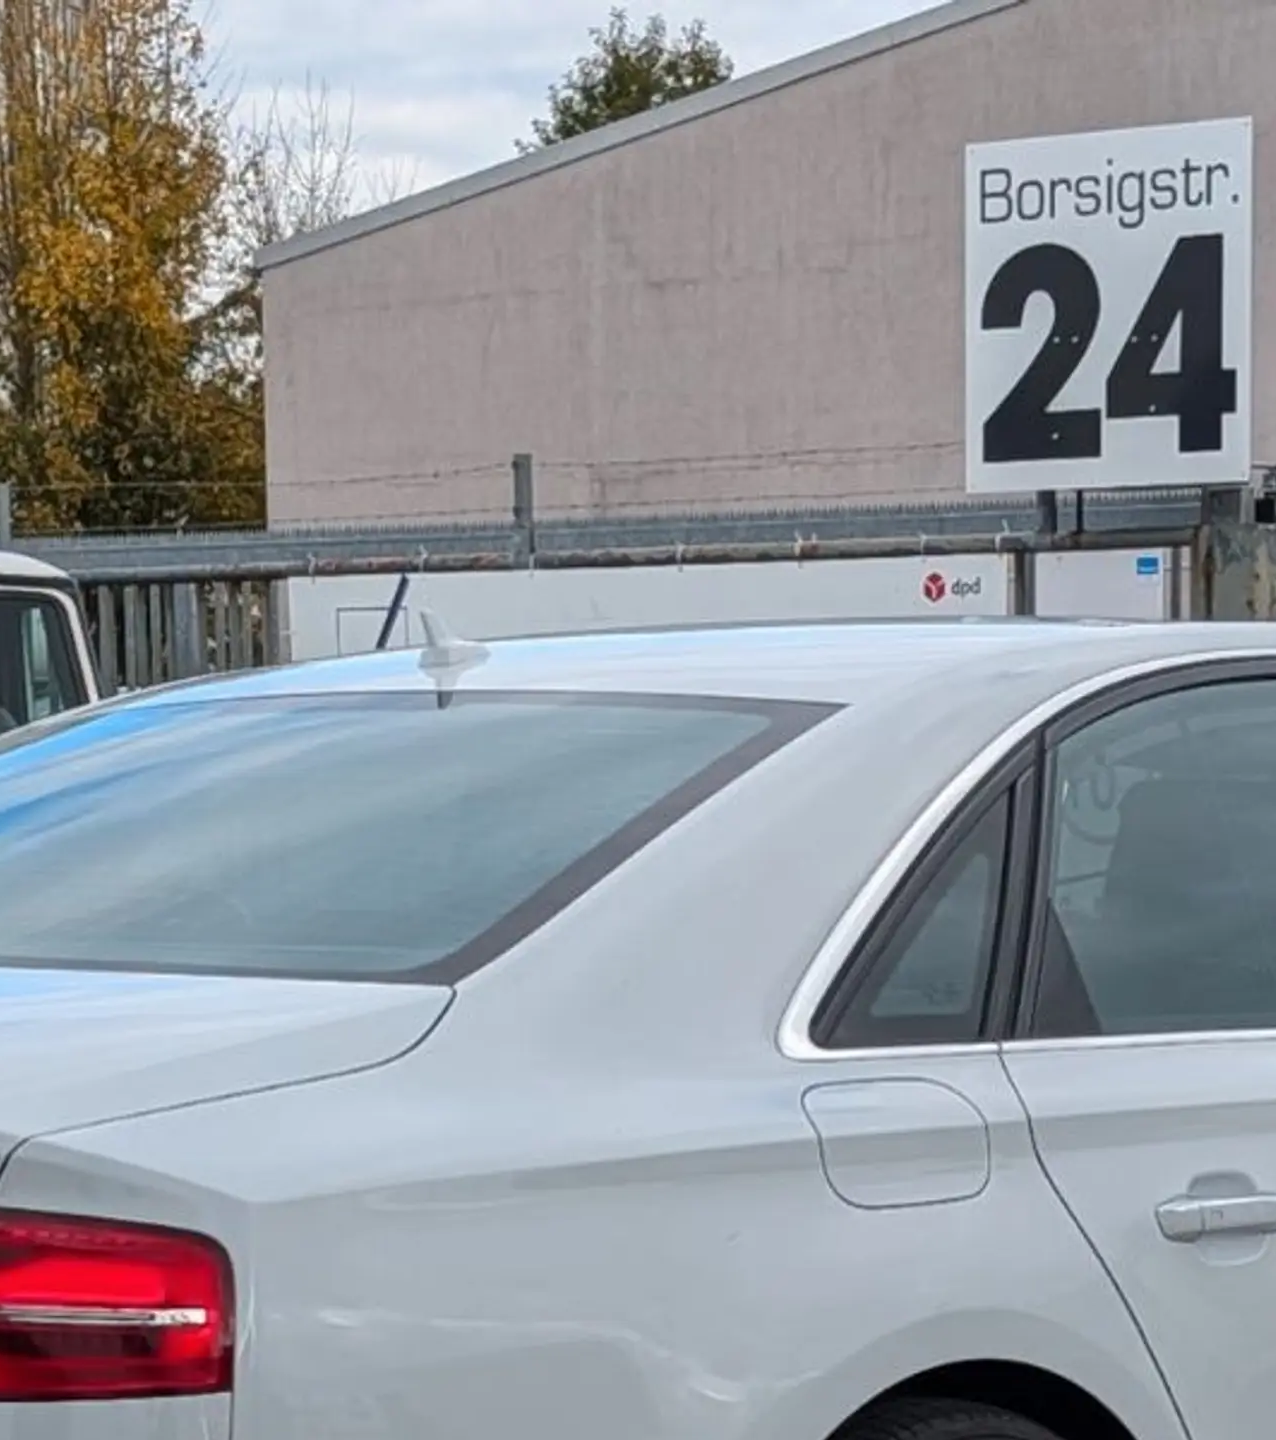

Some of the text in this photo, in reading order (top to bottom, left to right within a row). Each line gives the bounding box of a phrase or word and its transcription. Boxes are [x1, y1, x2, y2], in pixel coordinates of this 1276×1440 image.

[979, 157, 1240, 230] Borsigstr.
[980, 232, 1238, 463] 24
[950, 576, 982, 598] dpd
